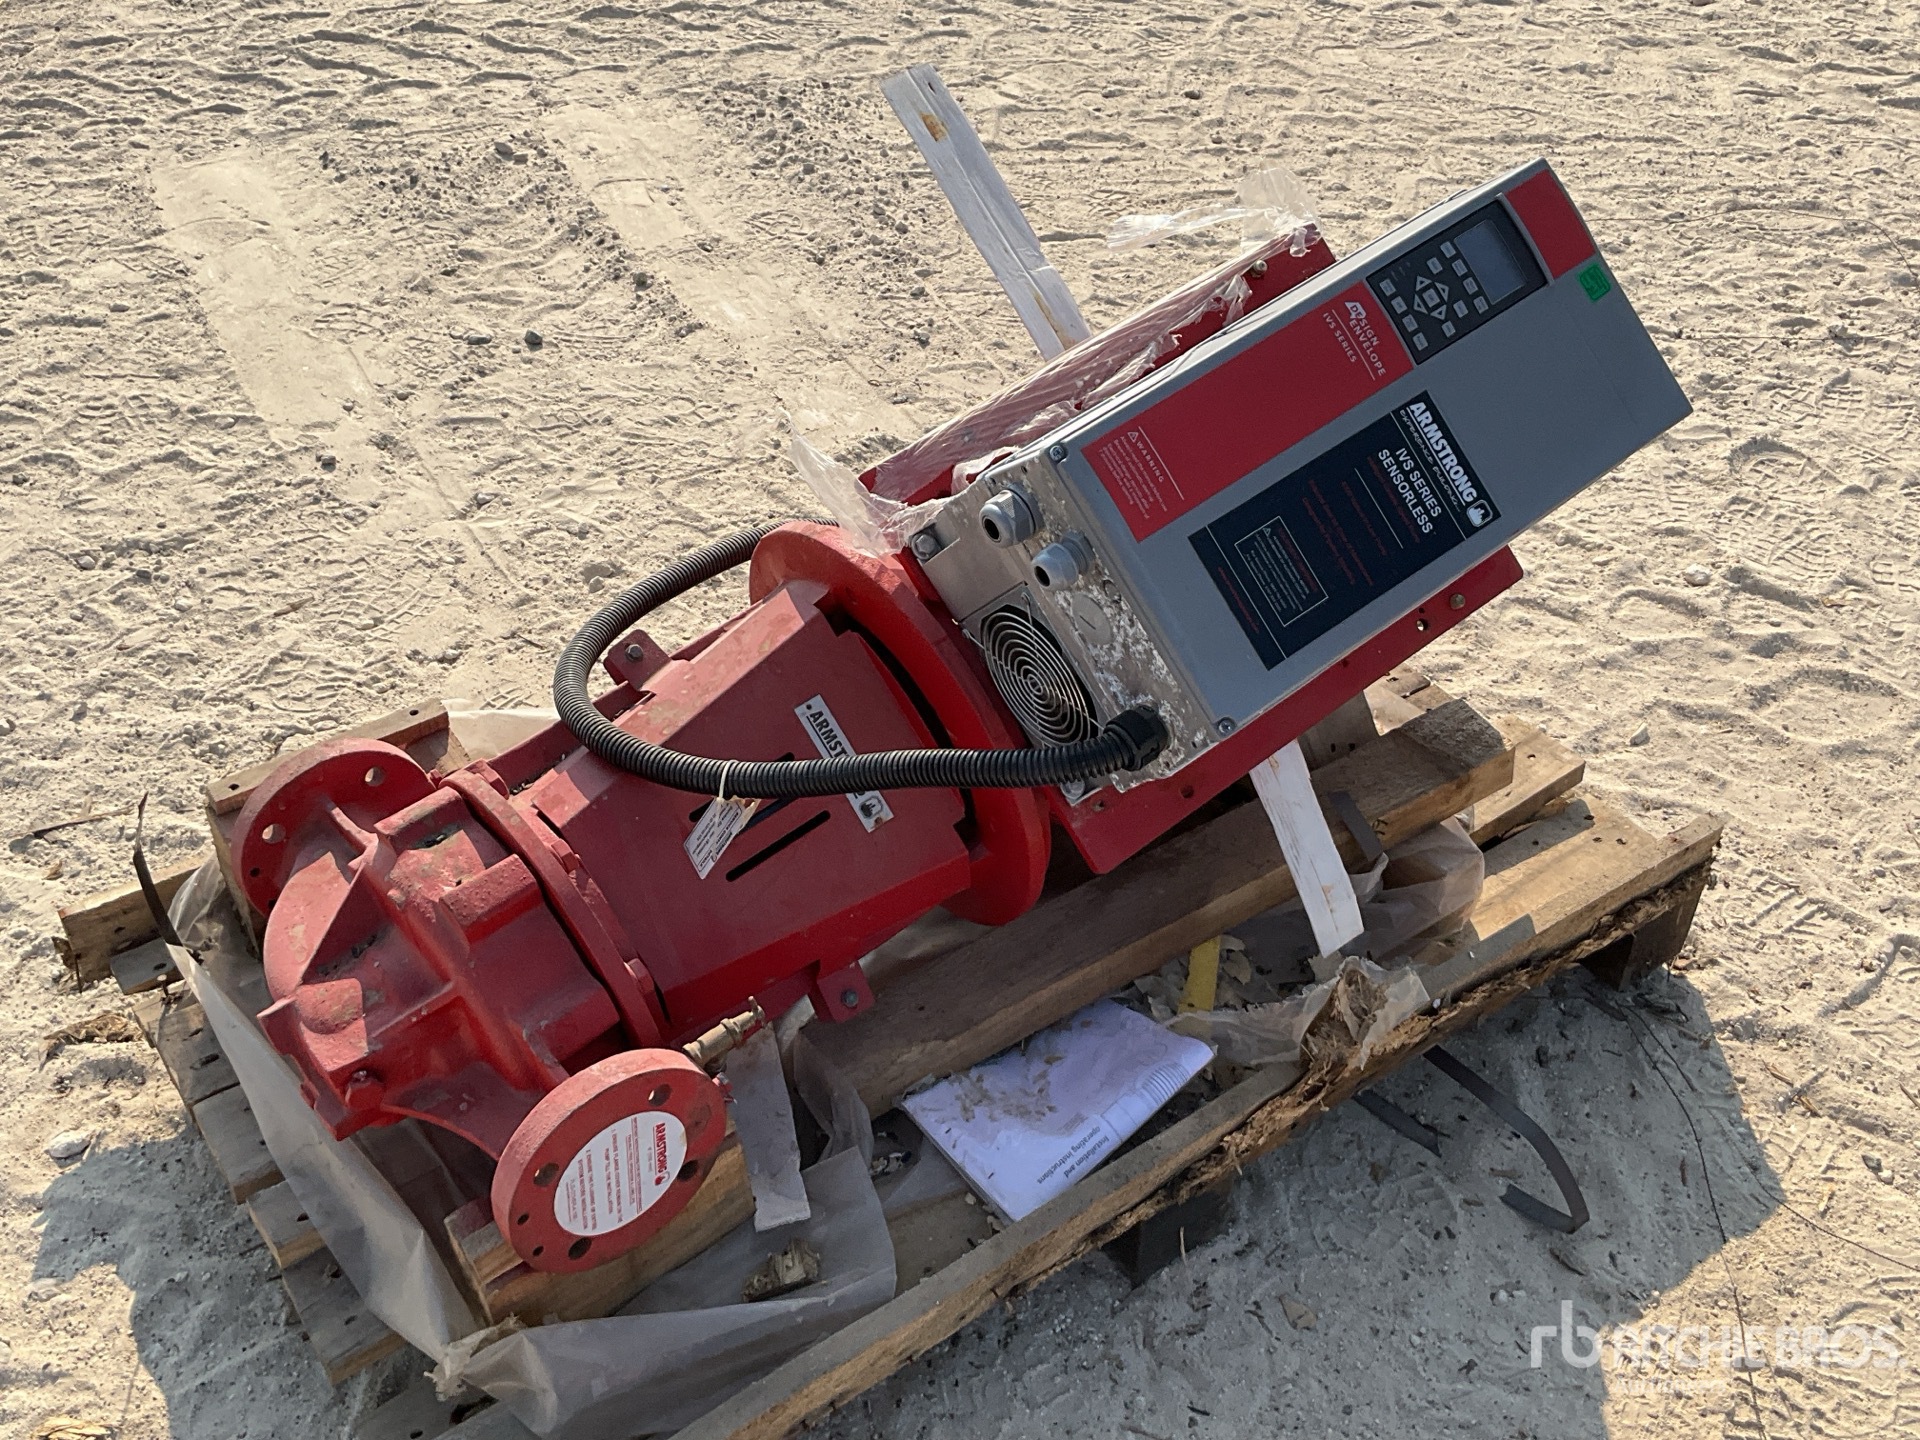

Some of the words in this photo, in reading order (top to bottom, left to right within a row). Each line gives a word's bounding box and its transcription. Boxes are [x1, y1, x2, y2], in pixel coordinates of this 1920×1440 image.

[1323, 312, 1336, 329] IVS
[1334, 329, 1357, 363] SERIES
[1349, 303, 1380, 346] DESIGN
[1349, 319, 1387, 377] ENVELOPE
[1137, 441, 1165, 483] WARNING
[1410, 401, 1478, 503] ARMSTRONG
[1378, 448, 1433, 534] SENSORLESS
[1396, 447, 1415, 471] IVS
[1409, 470, 1442, 518] SERIES
[655, 1122, 668, 1174] ARMSTRONG
[1070, 1126, 1101, 1153] operating
[1075, 1135, 1110, 1167] Installation
[1037, 1150, 1074, 1184] instructions
[1063, 1164, 1076, 1179] and
